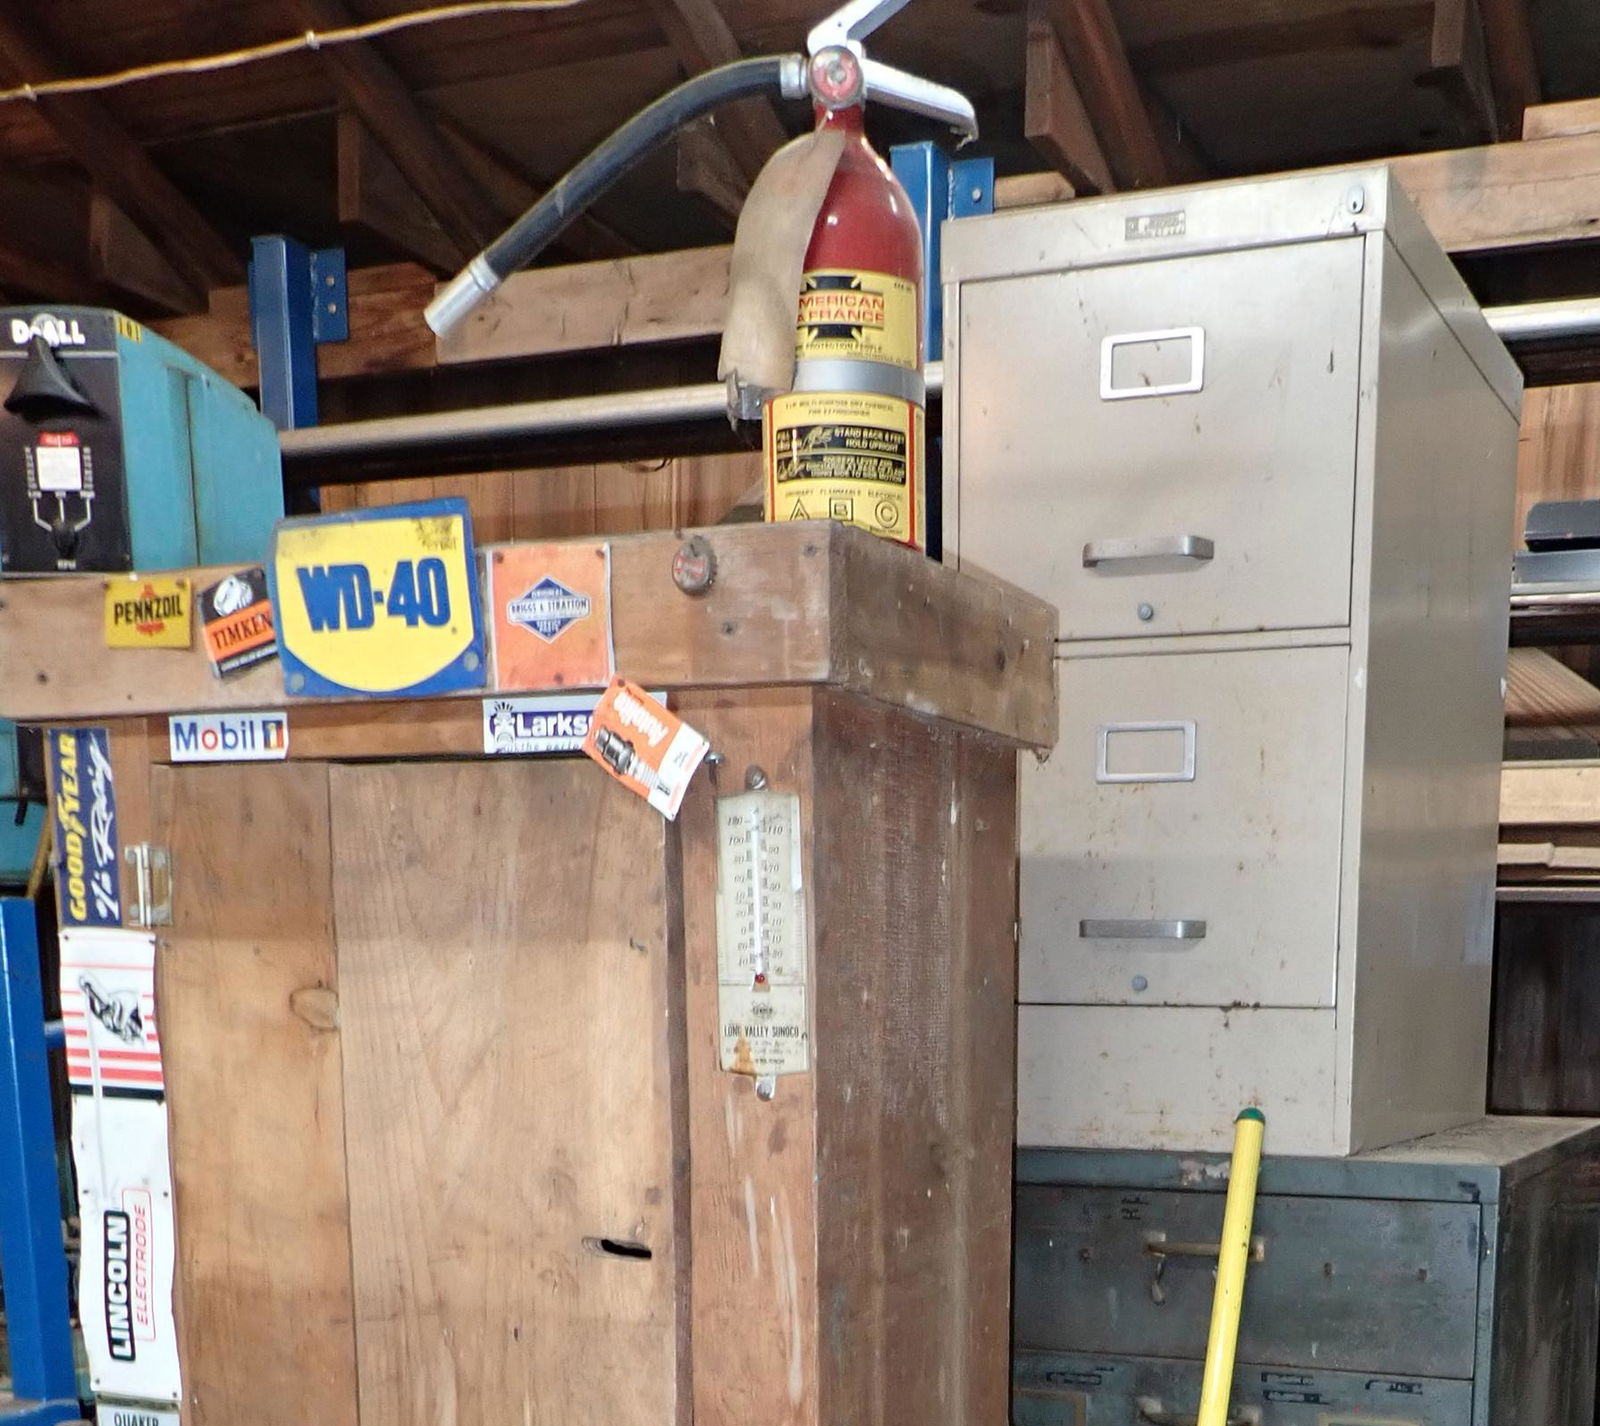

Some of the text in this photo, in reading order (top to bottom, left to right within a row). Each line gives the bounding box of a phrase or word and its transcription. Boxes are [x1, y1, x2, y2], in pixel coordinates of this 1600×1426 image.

[799, 293, 885, 309] MERICAN
[808, 308, 885, 323] FRANCE
[845, 438, 867, 449] HOLD
[296, 557, 451, 632] WD-40
[114, 595, 183, 626] PENNZOIL
[174, 720, 255, 752] Mobil
[745, 1025, 769, 1038] VALLEY
[771, 1025, 799, 1038] SUNOCO
[135, 1204, 148, 1327] ELECTRODE
[107, 1216, 131, 1357] LINCOLN
